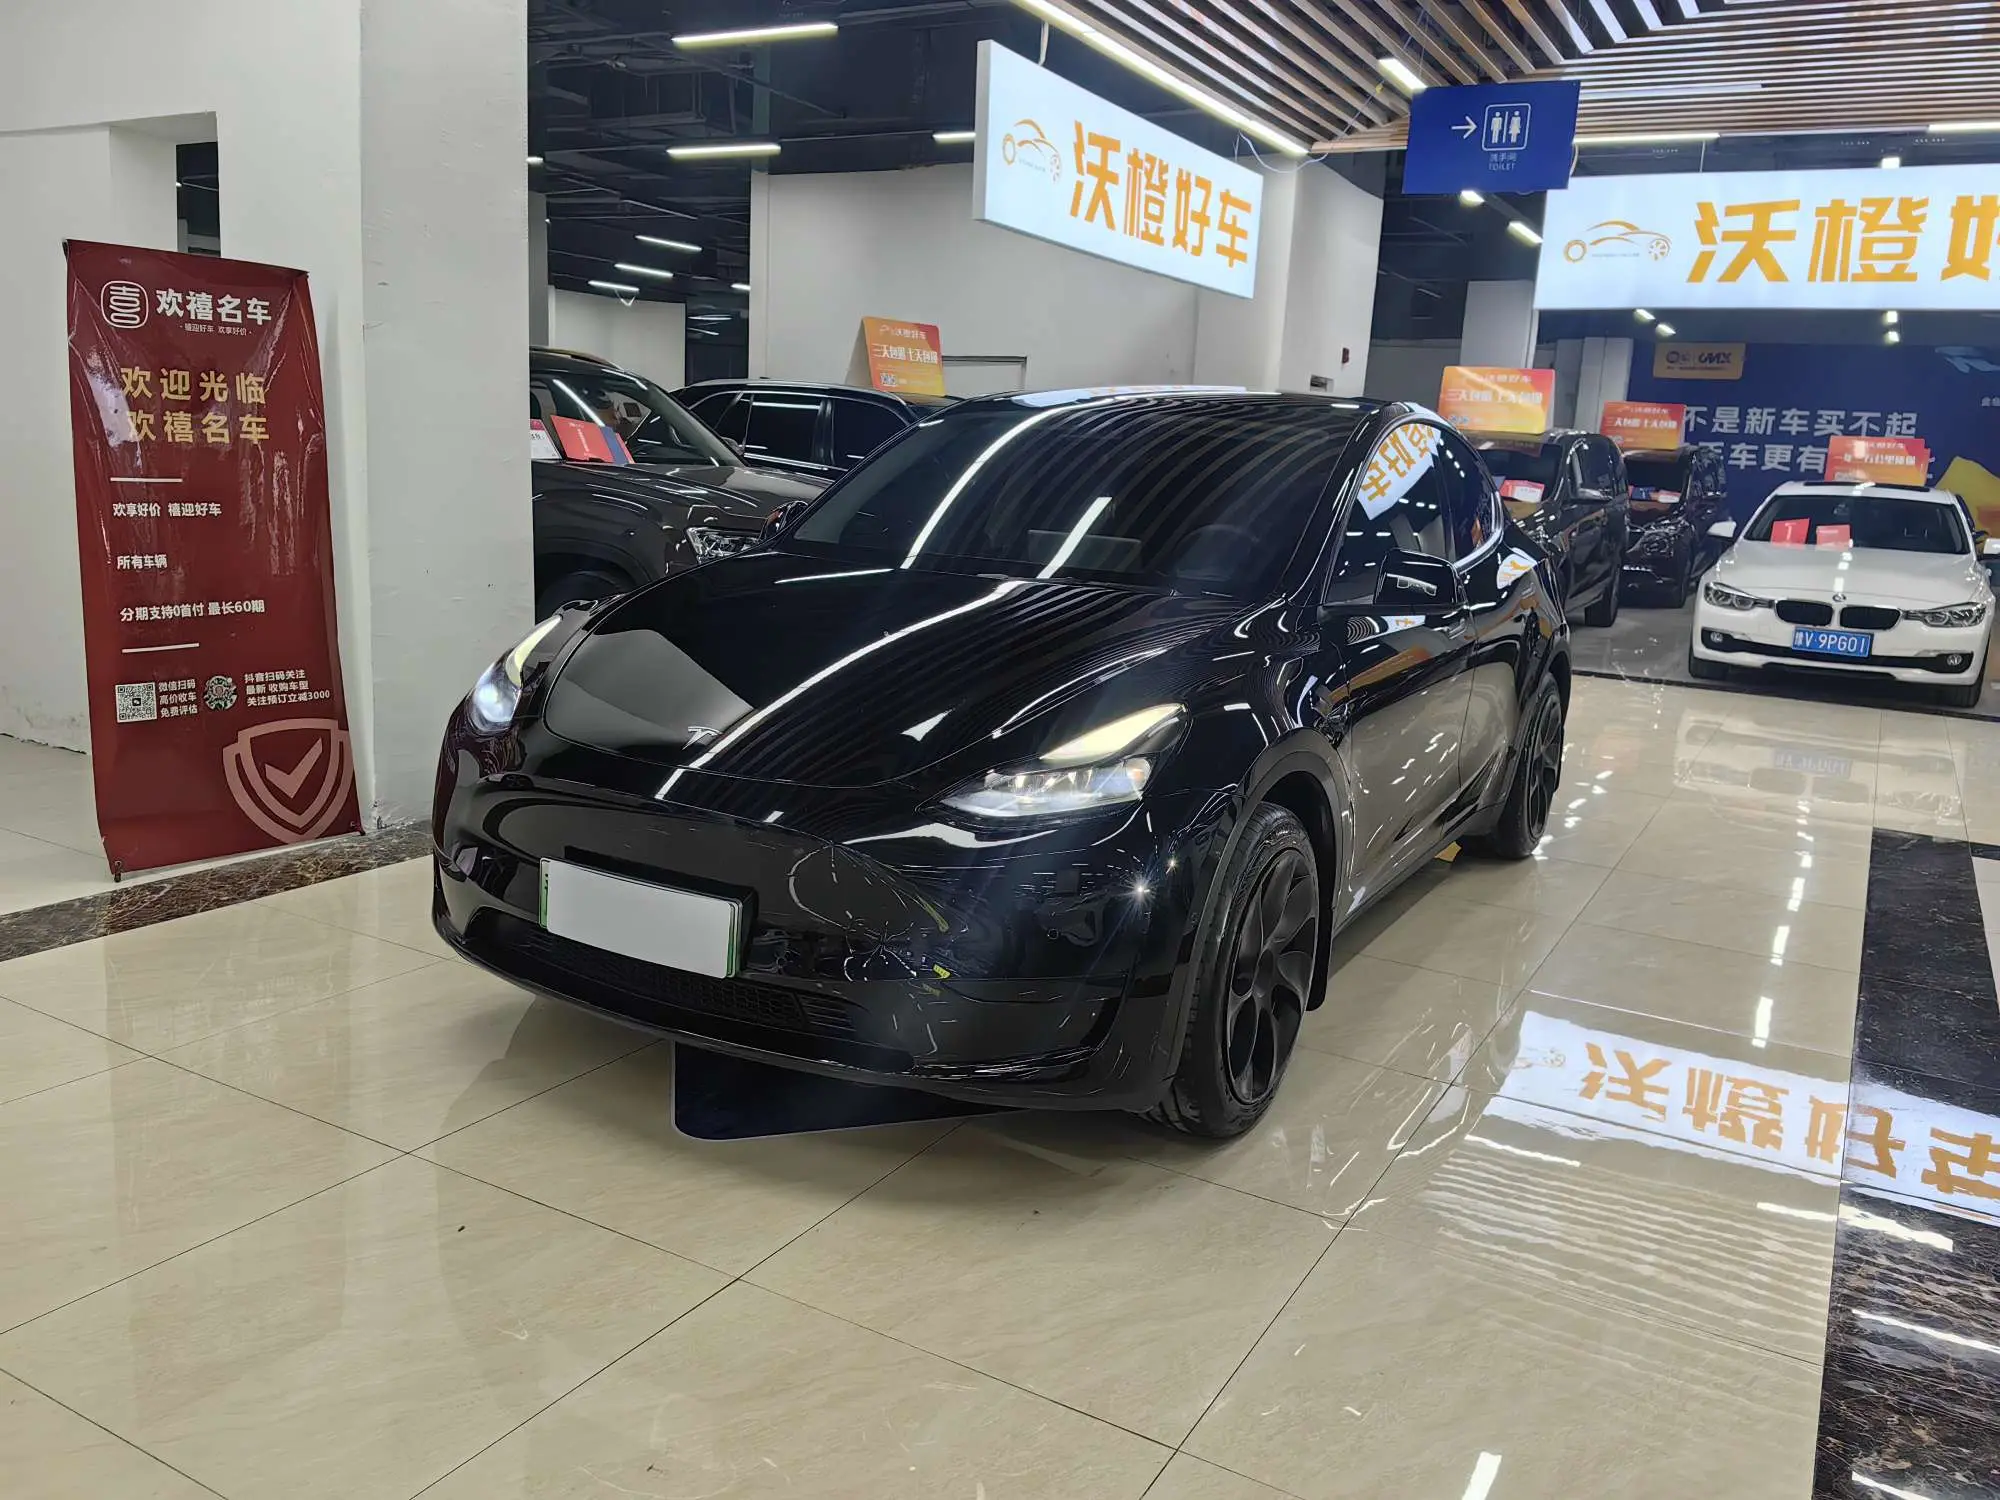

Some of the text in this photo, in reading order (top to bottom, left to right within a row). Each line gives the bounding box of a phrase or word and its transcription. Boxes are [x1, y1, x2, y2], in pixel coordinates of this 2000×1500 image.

[1069, 119, 1253, 269] 沃橙好车
[155, 288, 272, 326] 欢禧名车
[119, 366, 267, 405] 欢迎光临
[127, 410, 270, 445] 欢禧名车
[1684, 406, 1918, 439] 不是新车买不起
[112, 502, 222, 517] 欢享好价 禧迎好车
[116, 554, 168, 570] 所有车辆
[119, 600, 266, 623] 分期支持0首付 最长60期
[158, 679, 196, 693] 微信扫码
[244, 669, 306, 683] 抖音扫码关注
